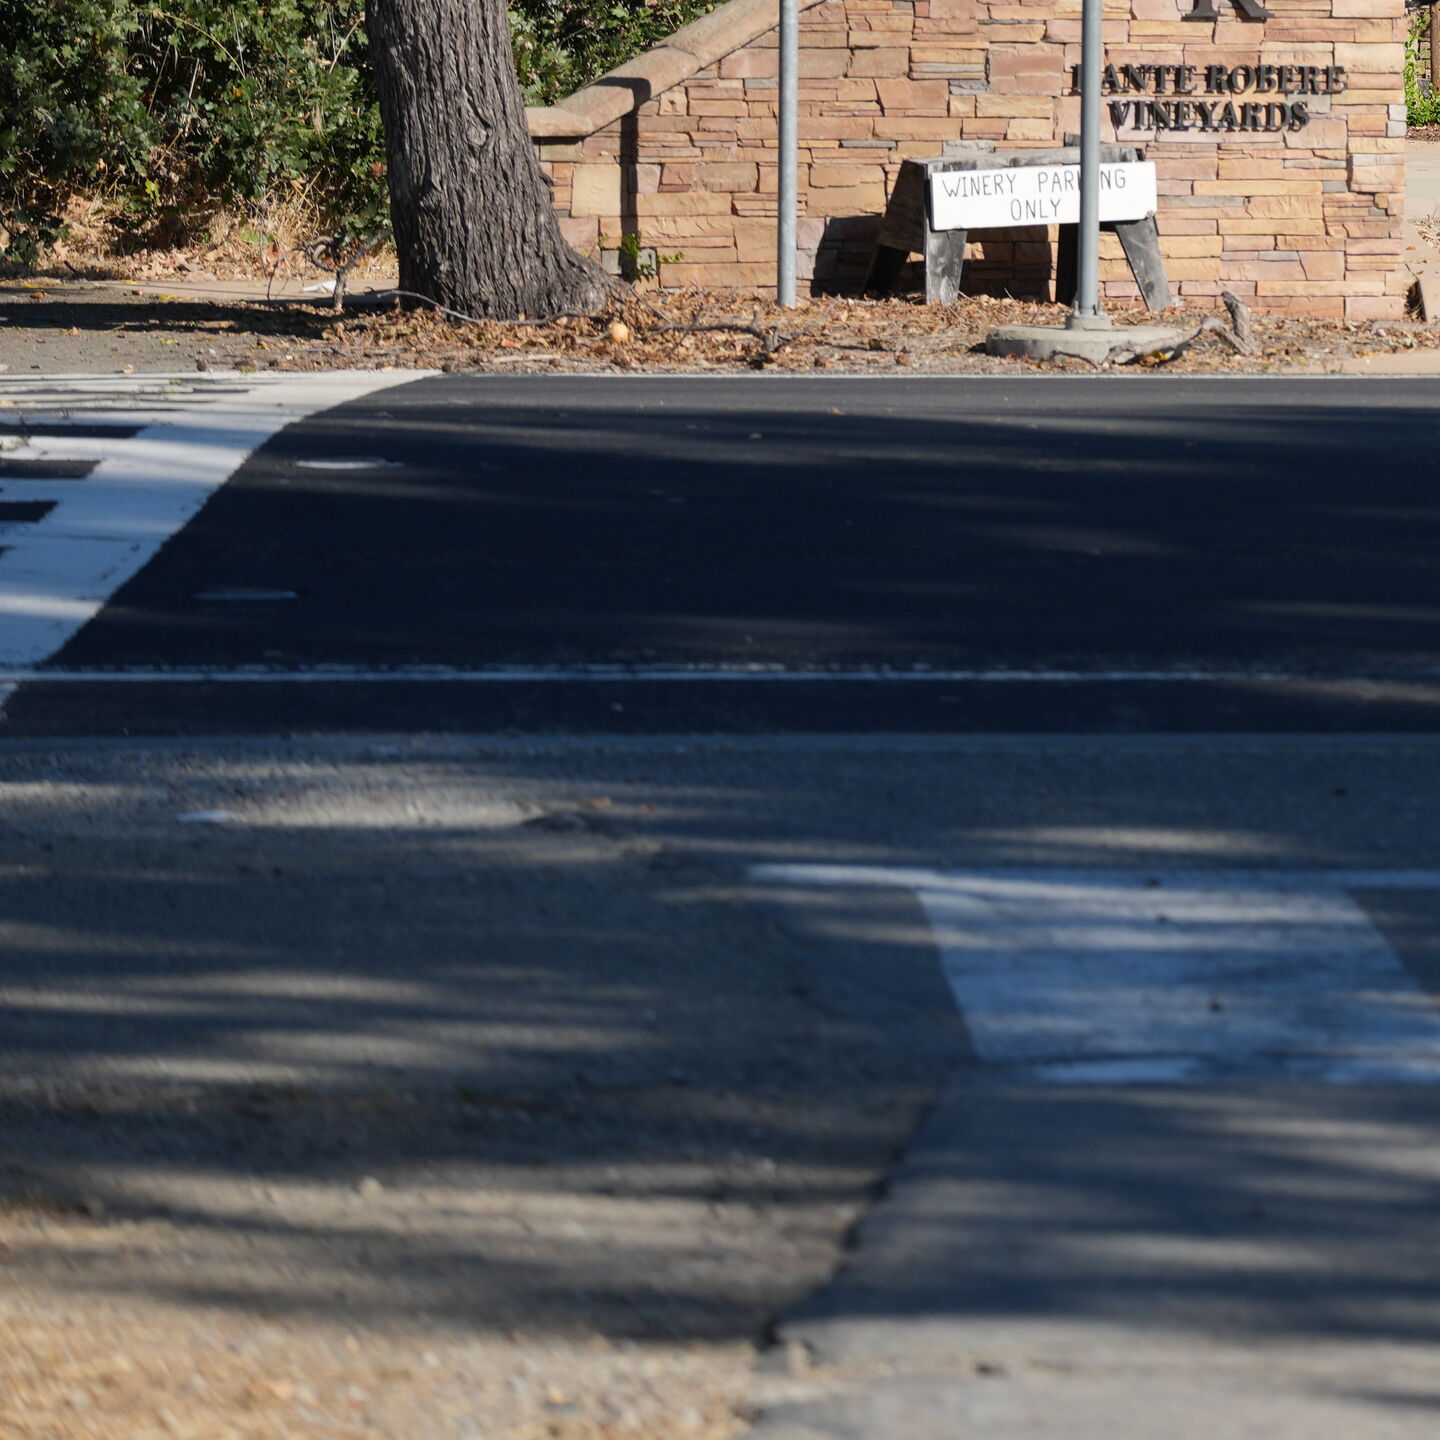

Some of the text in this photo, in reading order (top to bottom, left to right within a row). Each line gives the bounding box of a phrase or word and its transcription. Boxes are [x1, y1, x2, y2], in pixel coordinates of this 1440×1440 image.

[1204, 64, 1346, 94] ROBERE
[1108, 100, 1310, 131] VINEYARDS
[942, 168, 1126, 198] WINERY PARNG
[1010, 199, 1061, 221] ONLY
